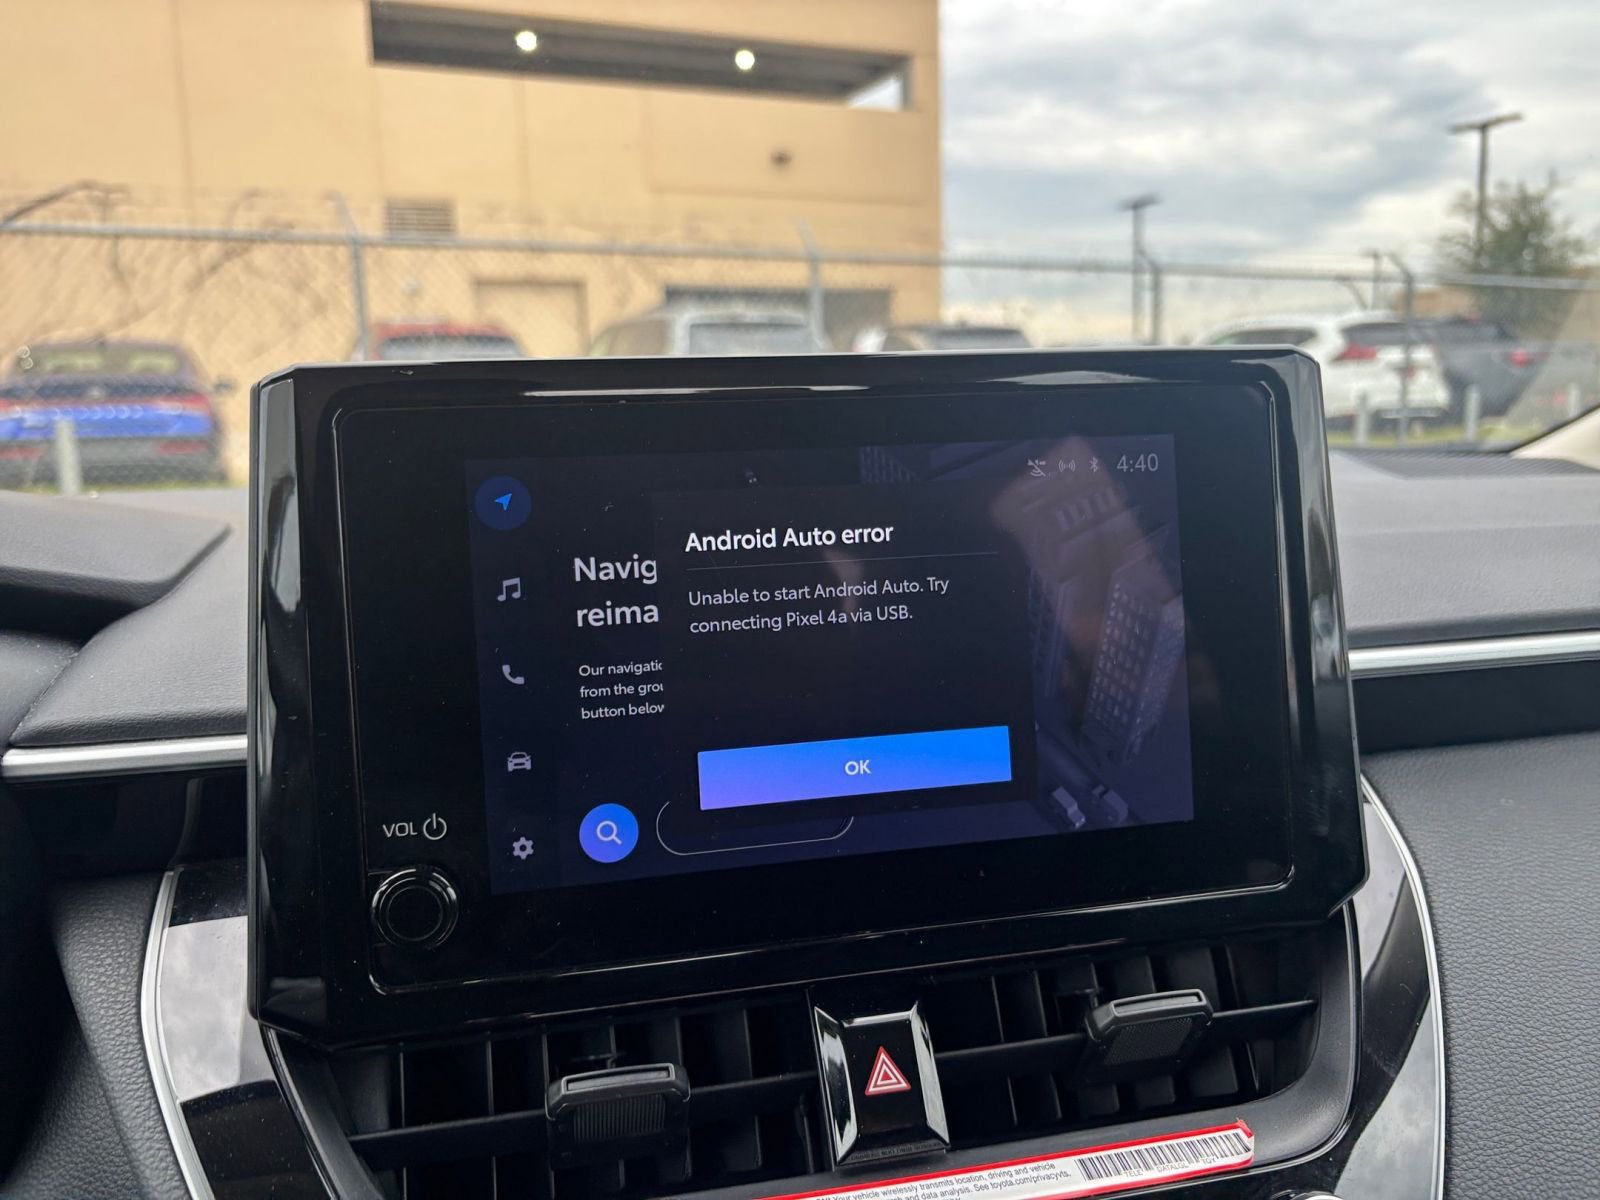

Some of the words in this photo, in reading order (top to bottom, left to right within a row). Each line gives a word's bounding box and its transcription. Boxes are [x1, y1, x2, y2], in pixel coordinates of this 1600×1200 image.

[1117, 453, 1159, 473] 4:40
[685, 527, 777, 552] Android
[783, 526, 836, 548] Auto
[841, 526, 894, 545] error
[573, 553, 658, 585] Navig
[688, 585, 750, 606] Unable
[752, 588, 771, 603] to
[774, 585, 811, 602] start
[813, 580, 878, 599] Android
[882, 577, 924, 595] Auto.
[927, 577, 950, 595] Try
[576, 600, 660, 628] reima
[689, 613, 783, 633] connecting
[786, 610, 825, 627] Pixel
[827, 609, 848, 624] 4a
[850, 608, 873, 623] via
[876, 605, 913, 621] USB.
[578, 664, 605, 677] Our
[580, 685, 611, 698] from
[613, 683, 635, 696] the
[581, 705, 626, 720] button
[844, 759, 872, 776] OK
[382, 821, 418, 838] VOL
[852, 1188, 880, 1200] vehicle
[881, 1183, 918, 1197] wirelessly
[919, 1178, 954, 1191] transmits
[955, 1173, 987, 1187] location,
[988, 1168, 1013, 1182] driving
[1014, 1165, 1029, 1177] and
[1031, 1162, 1056, 1173] vehicle
[921, 1188, 939, 1200] data
[940, 1185, 973, 1199] analysis.
[974, 1182, 990, 1193] See
